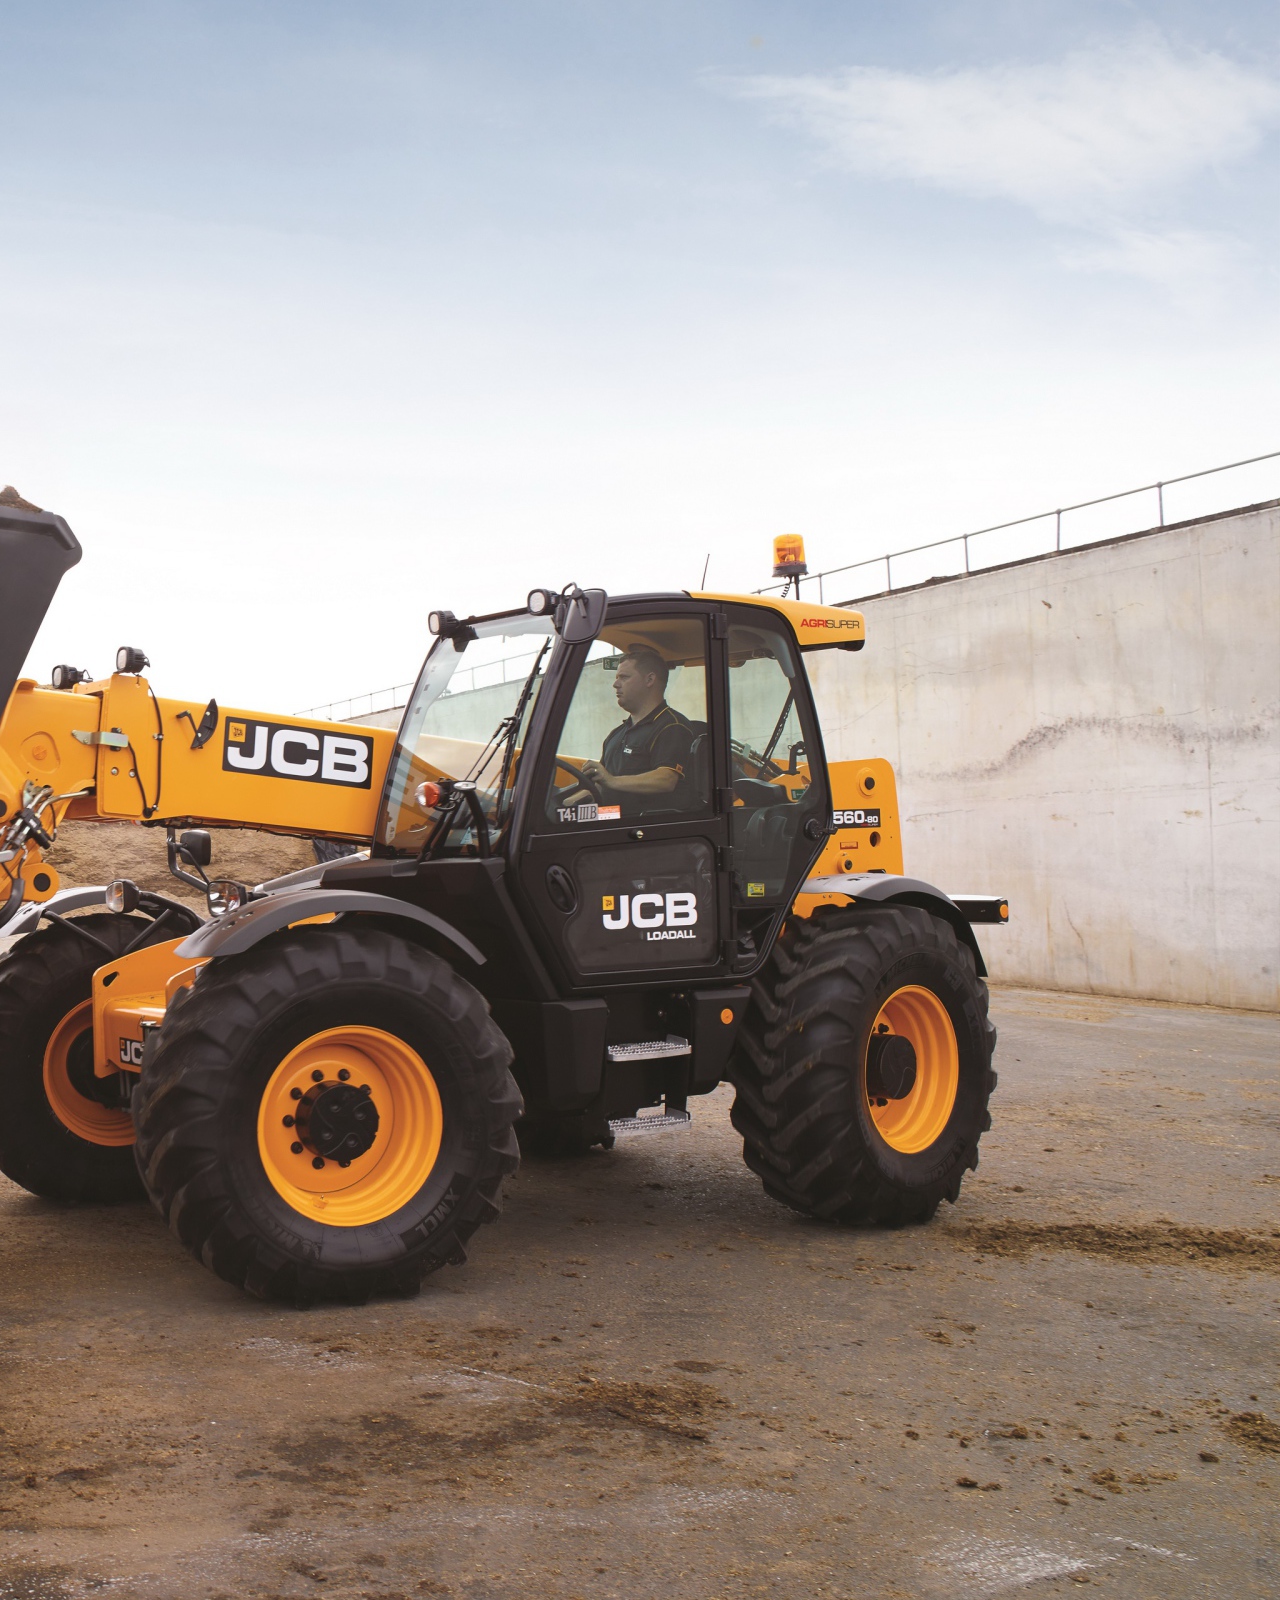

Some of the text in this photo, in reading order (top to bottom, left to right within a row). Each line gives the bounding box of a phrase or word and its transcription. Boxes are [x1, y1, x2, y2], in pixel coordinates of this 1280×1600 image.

[227, 725, 369, 783] JCB
[557, 807, 577, 822] T4i
[602, 892, 698, 930] JCB
[646, 929, 697, 941] LOADALL
[120, 1040, 144, 1066] JC
[415, 1187, 461, 1238] XMCL
